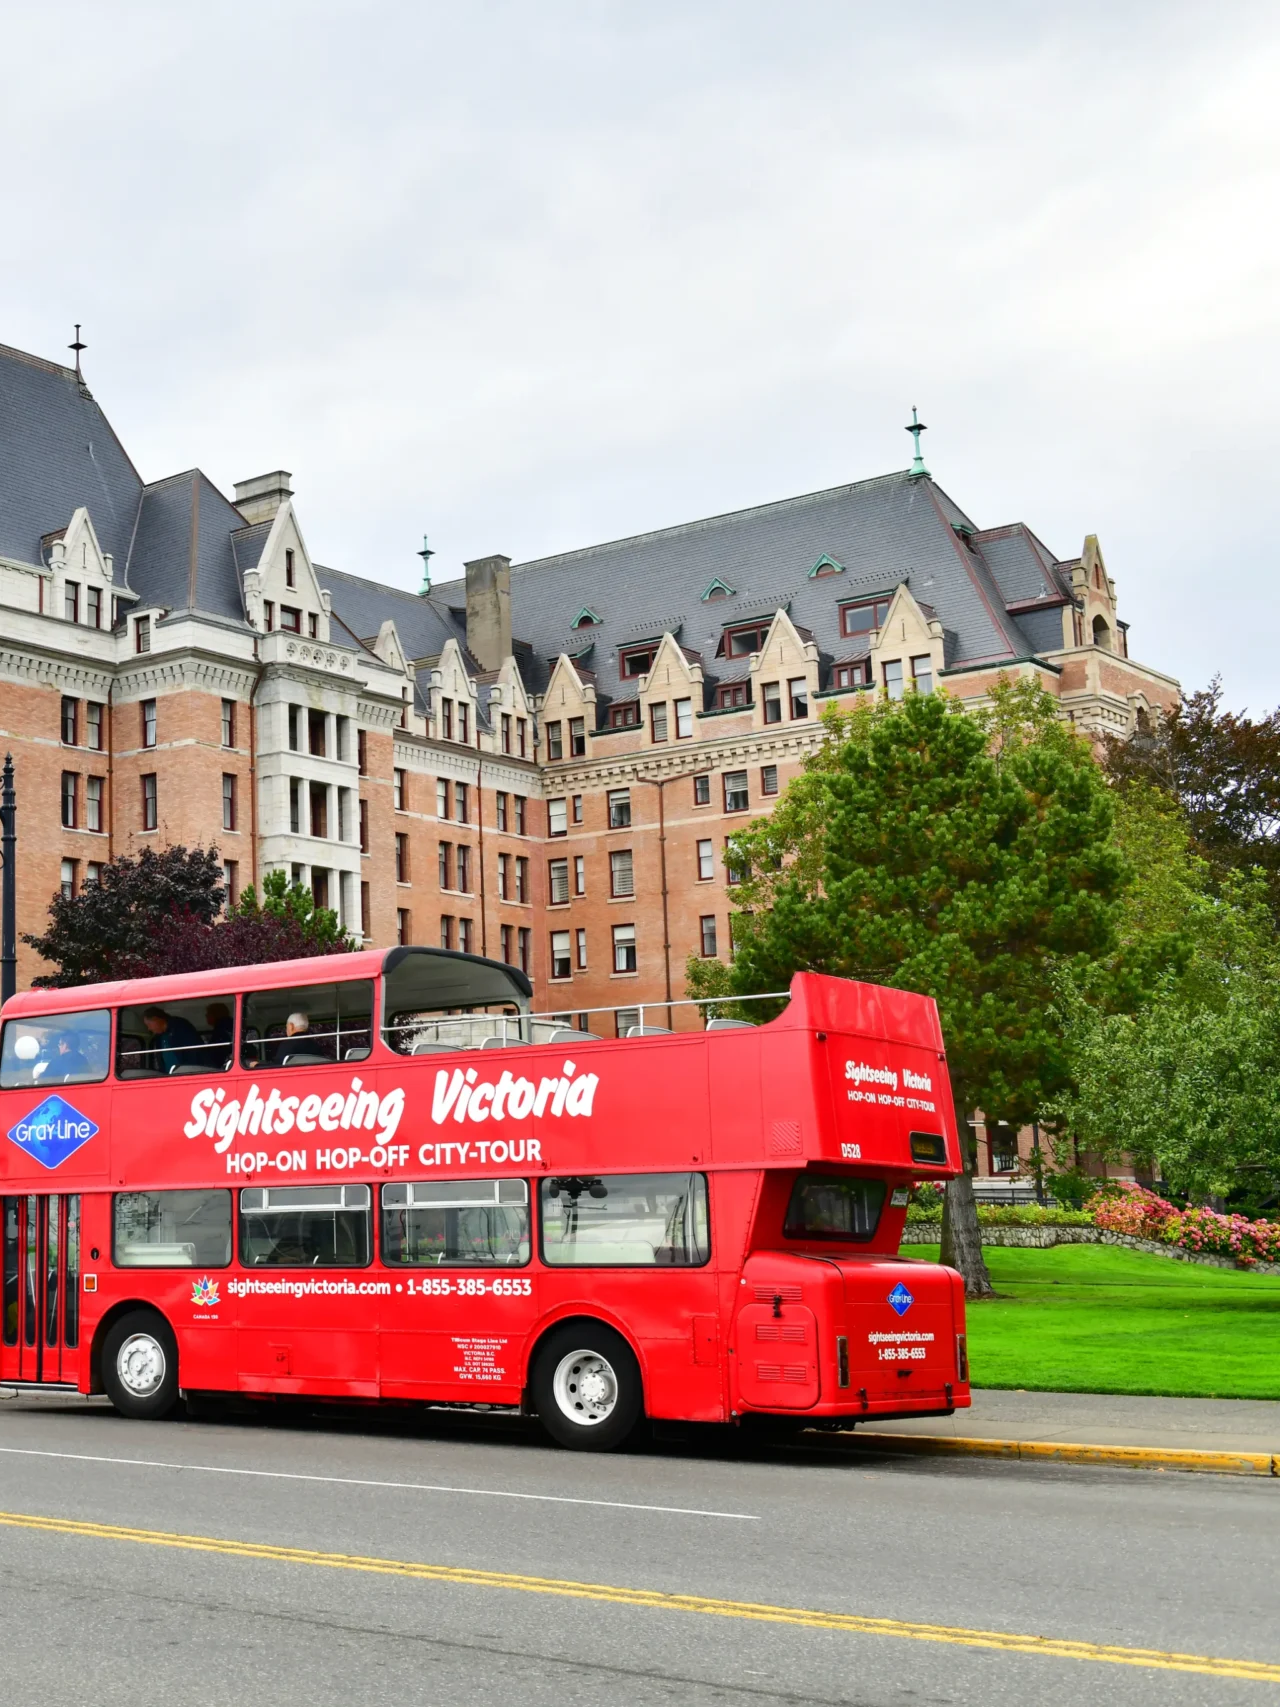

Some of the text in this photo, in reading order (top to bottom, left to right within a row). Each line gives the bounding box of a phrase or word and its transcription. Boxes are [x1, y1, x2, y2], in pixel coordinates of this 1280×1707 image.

[845, 1060, 932, 1092] Sightseeing Victoria
[183, 1060, 599, 1153] Sightseeing Victoria
[847, 1090, 935, 1112] HOP-ON HOP-OFF CITY-TOUR
[226, 1138, 542, 1174] HOP-ON HOP-OFF CITY-TOUR
[841, 1143, 861, 1159] D528
[227, 1278, 532, 1298] sightseeingvictoria.com 1-855-385-6553
[868, 1331, 935, 1345] sightseeingvictoria.com
[878, 1348, 926, 1360] 1-855-385-6553
